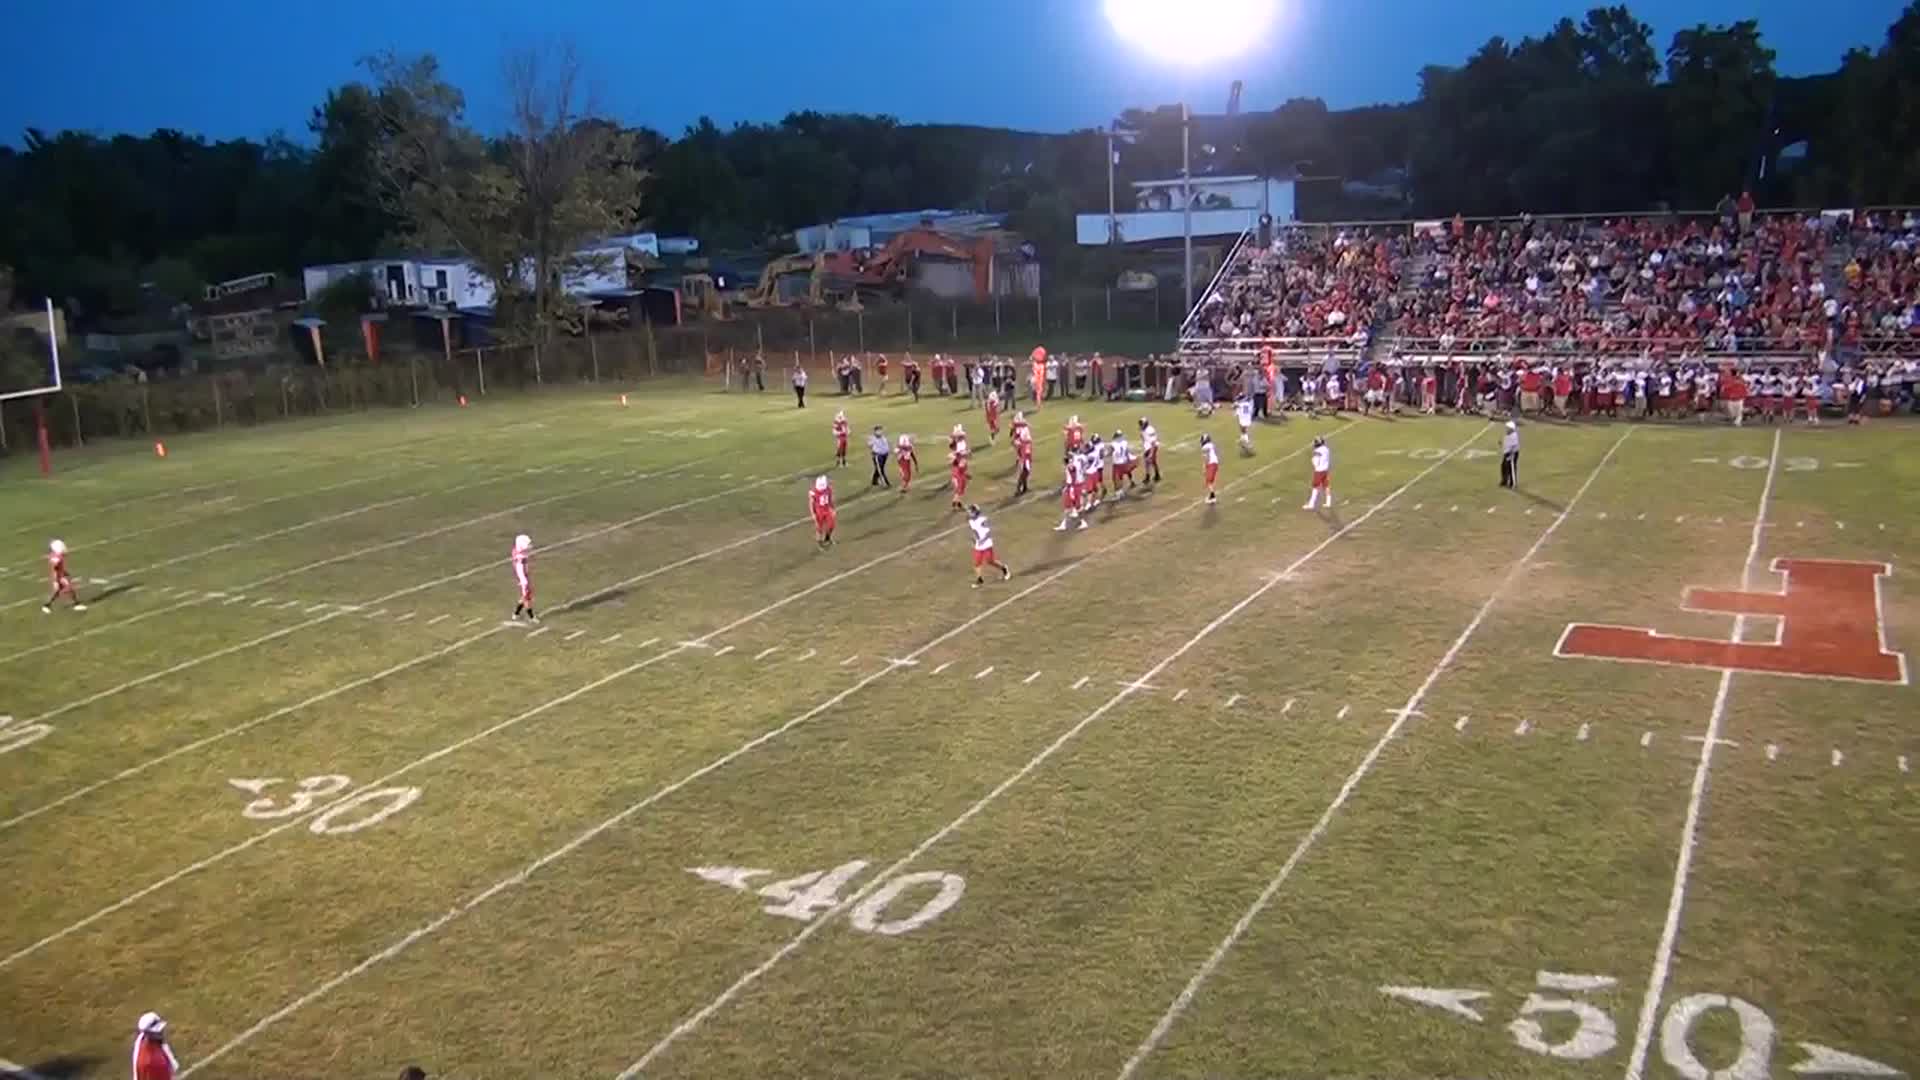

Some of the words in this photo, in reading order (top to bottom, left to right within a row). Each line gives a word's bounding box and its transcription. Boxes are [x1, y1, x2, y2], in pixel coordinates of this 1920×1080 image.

[1552, 557, 1909, 685] F
[241, 774, 422, 834] 30
[756, 860, 967, 935] 40
[1508, 970, 1776, 1080] 50
